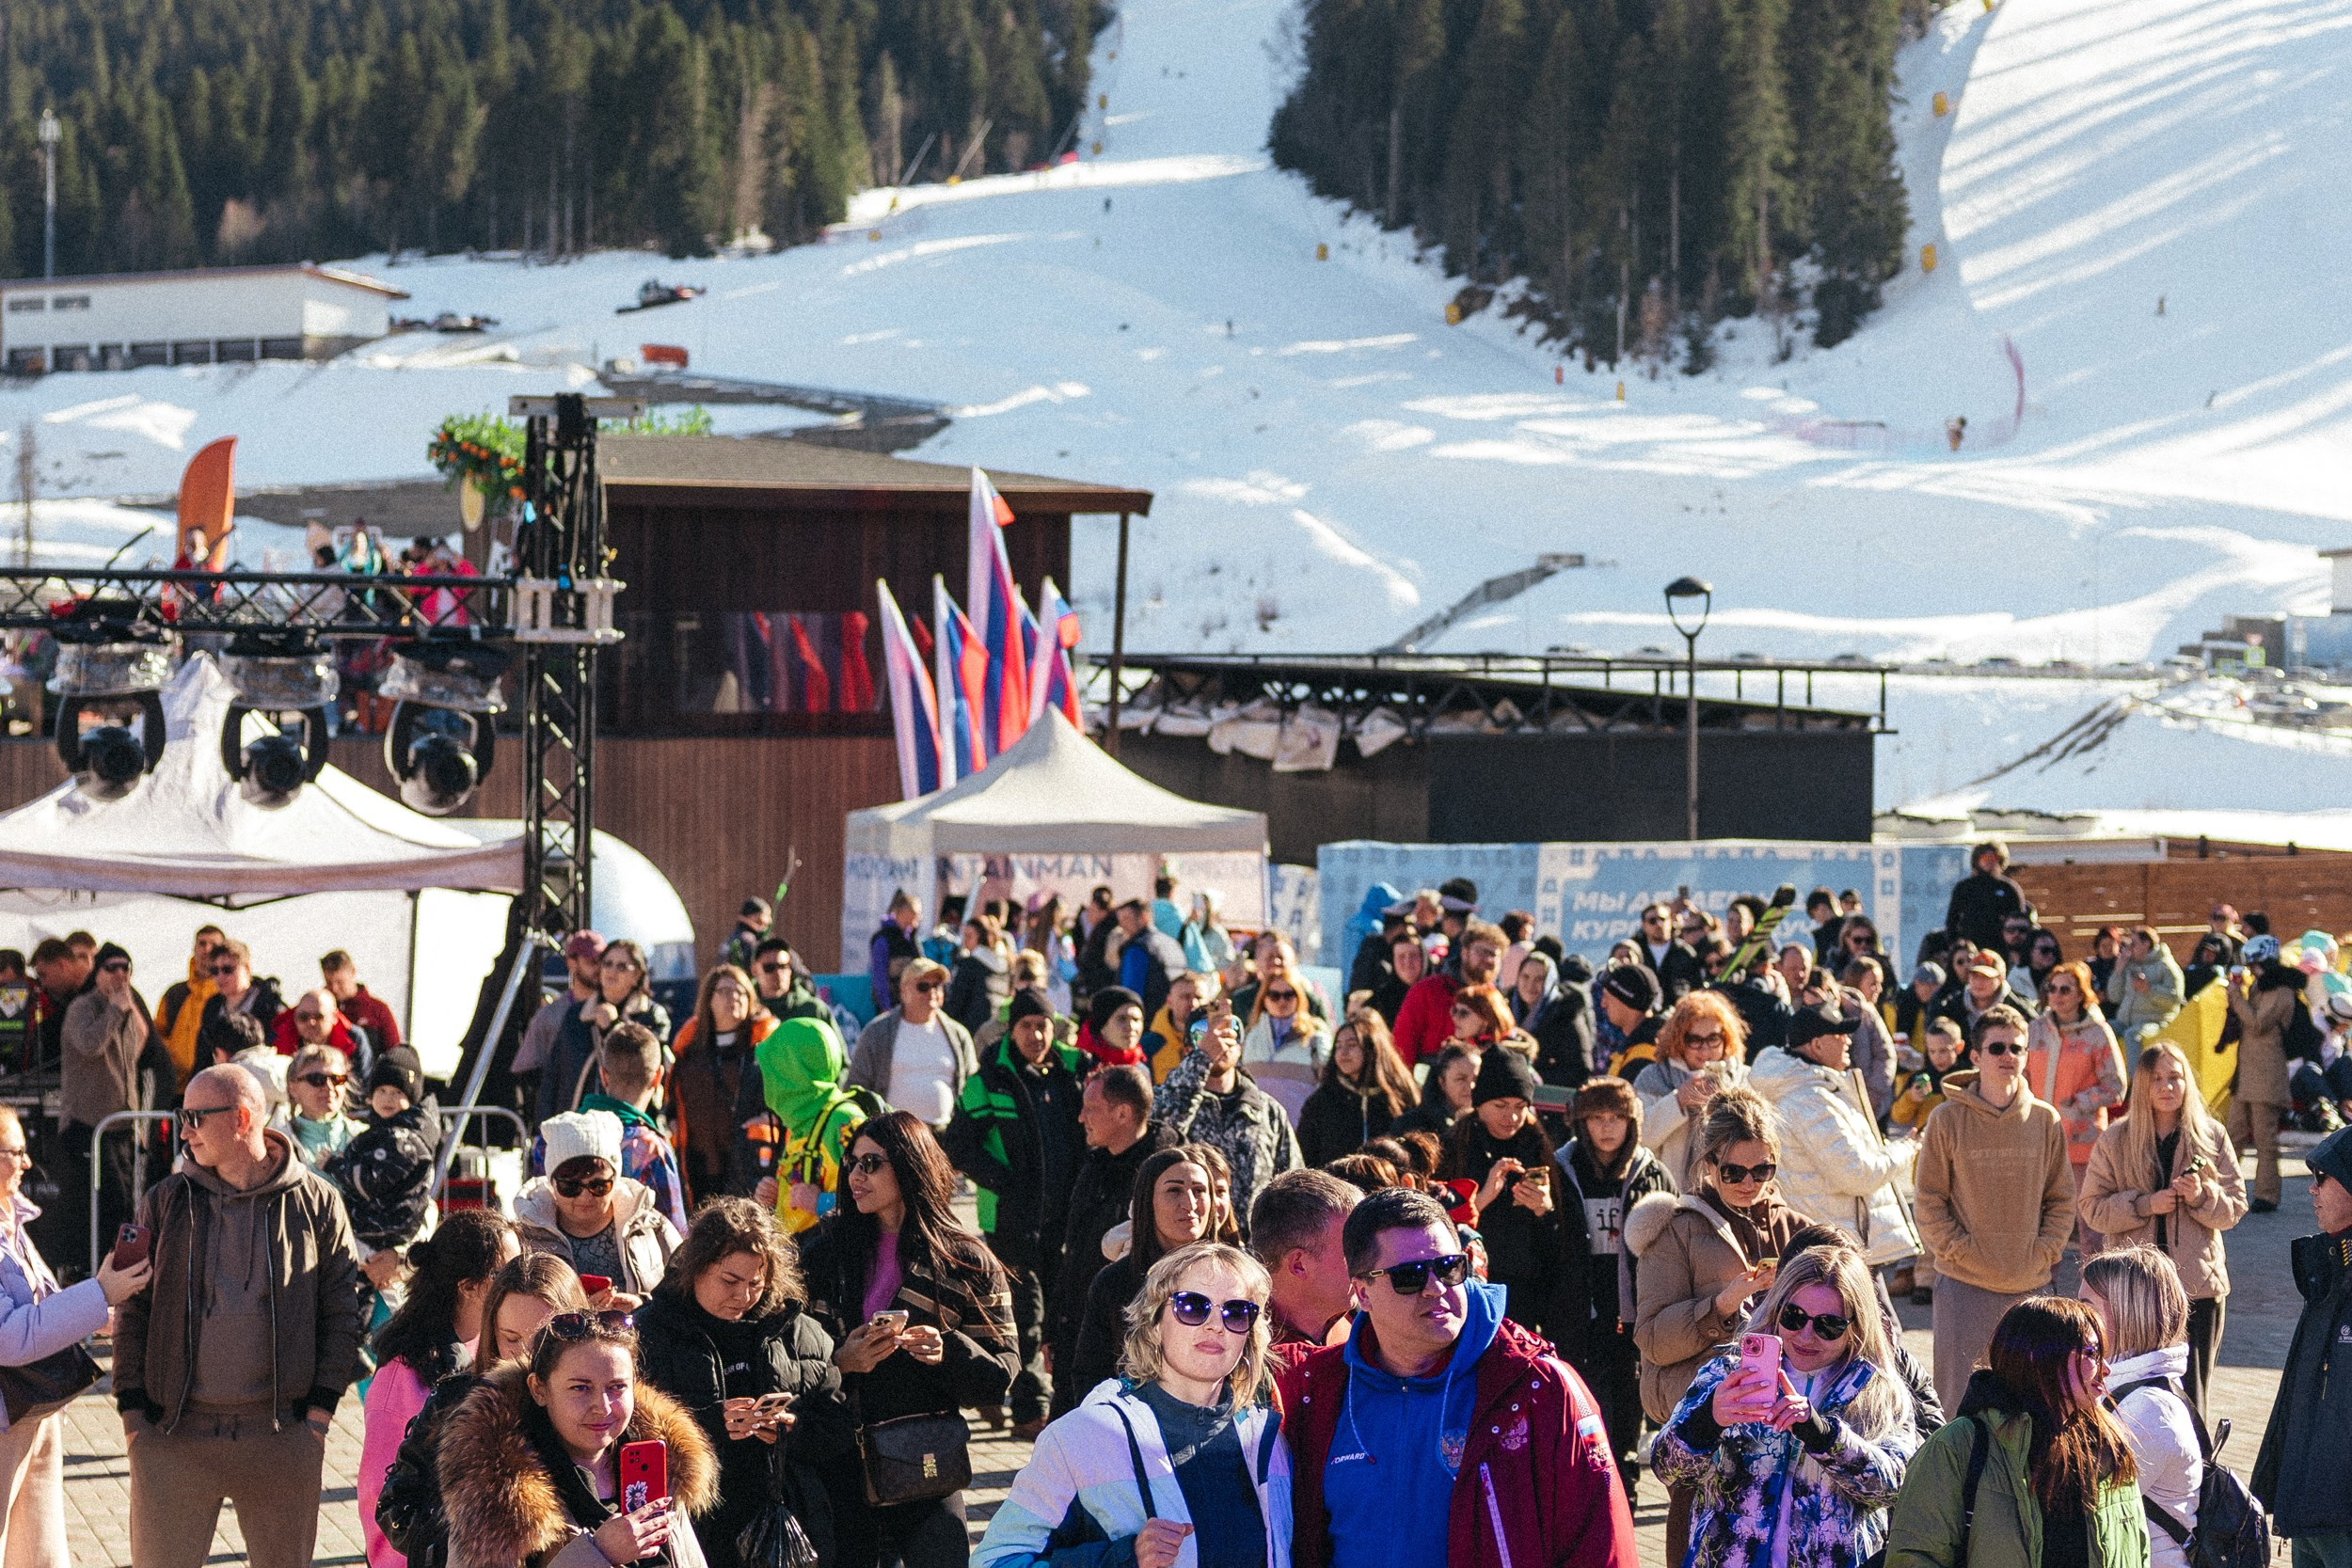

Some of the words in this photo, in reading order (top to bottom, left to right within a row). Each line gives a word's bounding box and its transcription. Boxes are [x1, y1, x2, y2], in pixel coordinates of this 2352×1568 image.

[1572, 891, 1627, 912] МЫ
[1597, 1208, 1620, 1231] if
[736, 1362, 745, 1370] OF
